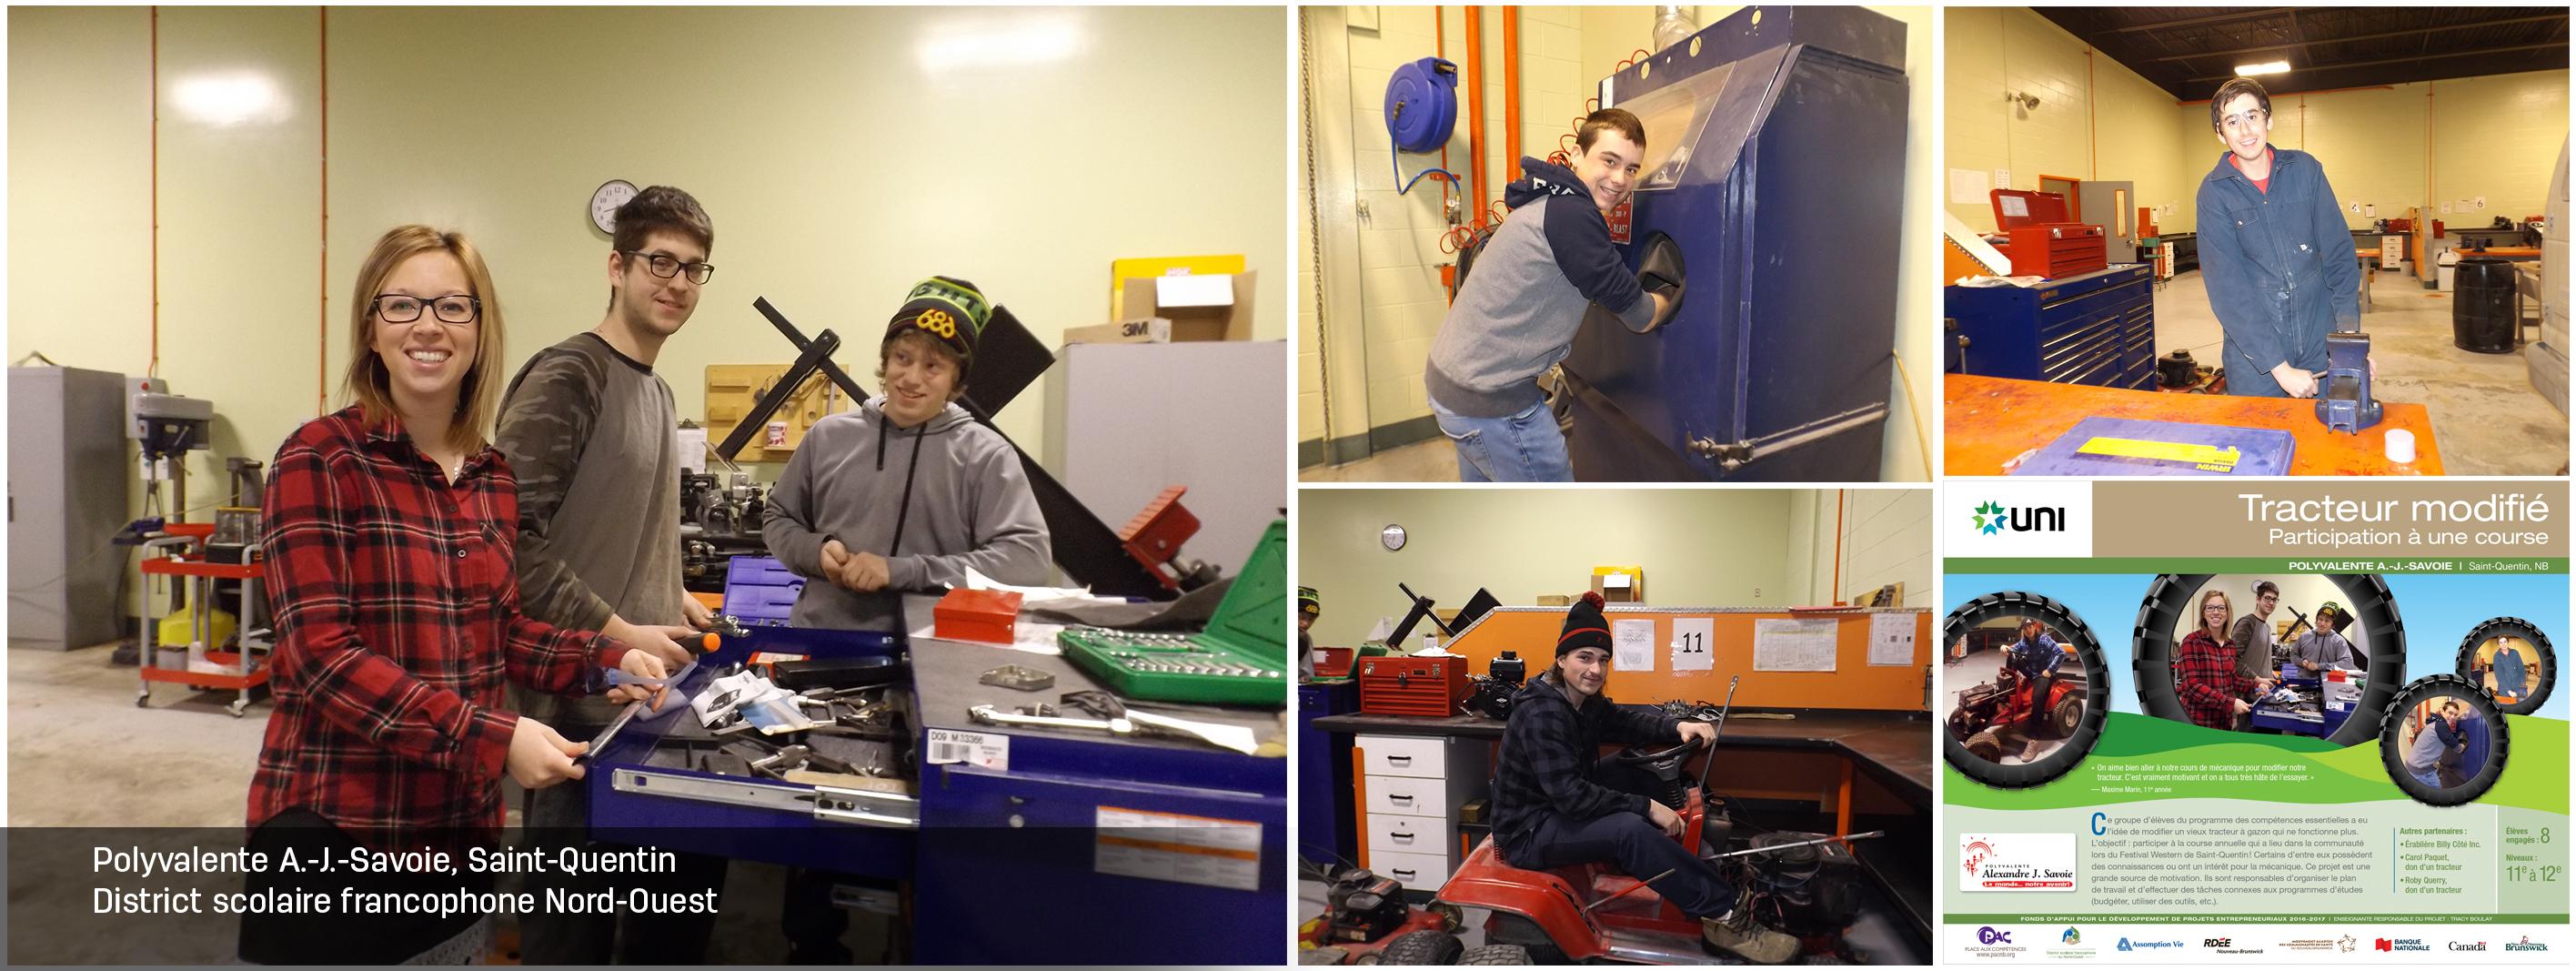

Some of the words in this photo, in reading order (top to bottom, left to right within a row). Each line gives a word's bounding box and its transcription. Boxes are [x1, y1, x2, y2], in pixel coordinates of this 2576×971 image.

[1122, 321, 1149, 338] 3M
[2238, 493, 2400, 522] Tracteur
[2411, 492, 2550, 522] modifié
[2269, 528, 2401, 549] Participation
[2408, 528, 2422, 545] à
[2428, 531, 2469, 545] une
[2474, 531, 2550, 545] course
[2289, 561, 2374, 571] POLYVALENTE
[2376, 561, 2453, 571] A.-J.-SAVOIE
[2469, 561, 2532, 571] Saint-Quentin,
[2534, 561, 2550, 571] NB
[1681, 632, 1705, 653] 11
[951, 733, 959, 743] M
[2106, 764, 2125, 772] aime
[2125, 764, 2141, 772] bien
[2140, 764, 2155, 772] aller
[2161, 764, 2179, 772] notre
[2209, 764, 2245, 774] mécanique
[2245, 764, 2260, 774] pour
[2261, 764, 2289, 772] modifier
[2289, 764, 2307, 772] notre
[2400, 827, 2423, 836] Autres
[2423, 827, 2464, 836] partenaires
[2505, 826, 2529, 835] Élèves
[2540, 826, 2551, 844] 8
[2404, 839, 2435, 848] Érablière
[2436, 840, 2451, 849] Billy
[2452, 839, 2468, 848] Côté
[2469, 840, 2481, 848] Inc.
[2505, 836, 2536, 845] engagés
[2090, 851, 2106, 859] lors
[2119, 850, 2149, 859] Festival
[2149, 851, 2183, 859] Western
[2195, 850, 2252, 860] Saint-Quentin!
[2253, 851, 2288, 859] Certains
[2287, 851, 2317, 859] d'entre
[2331, 850, 2373, 860] possèdent
[2404, 853, 2423, 861] Carol
[2424, 853, 2450, 863] Paquet,
[2505, 854, 2533, 862] Niveaux
[2404, 863, 2418, 871] don
[2419, 863, 2435, 871] d'un
[2435, 863, 2463, 871] tracteur
[1982, 868, 2030, 878] Alexandre
[2031, 868, 2041, 879] J.
[2043, 868, 2073, 878] Savoie
[2506, 865, 2528, 882] 11e
[2529, 868, 2537, 882] à
[2539, 865, 2562, 882] 12e
[2090, 874, 2118, 884] grande
[2159, 874, 2202, 882] motivation.
[2204, 874, 2213, 882] Ils
[2233, 874, 2285, 884] responsables
[2286, 874, 2330, 884] d'organiser
[2340, 874, 2359, 884] plan
[2404, 875, 2422, 885] Roby
[2423, 875, 2448, 885] Querry,
[2103, 885, 2127, 894] travail
[2137, 885, 2179, 894] d'effectuer
[2180, 885, 2196, 894] des
[2196, 885, 2223, 894] tâches
[2277, 887, 2329, 895] programmes
[2329, 885, 2364, 894] d'études
[2404, 885, 2418, 894] don
[2419, 885, 2435, 894] d'un
[2435, 885, 2463, 894] tracteur
[2132, 940, 2172, 951] Assomption
[2172, 940, 2184, 948] Vie
[2203, 937, 2232, 947] RDÉE
[2448, 940, 2487, 952] Canada
[2505, 942, 2549, 952] Brunswick
